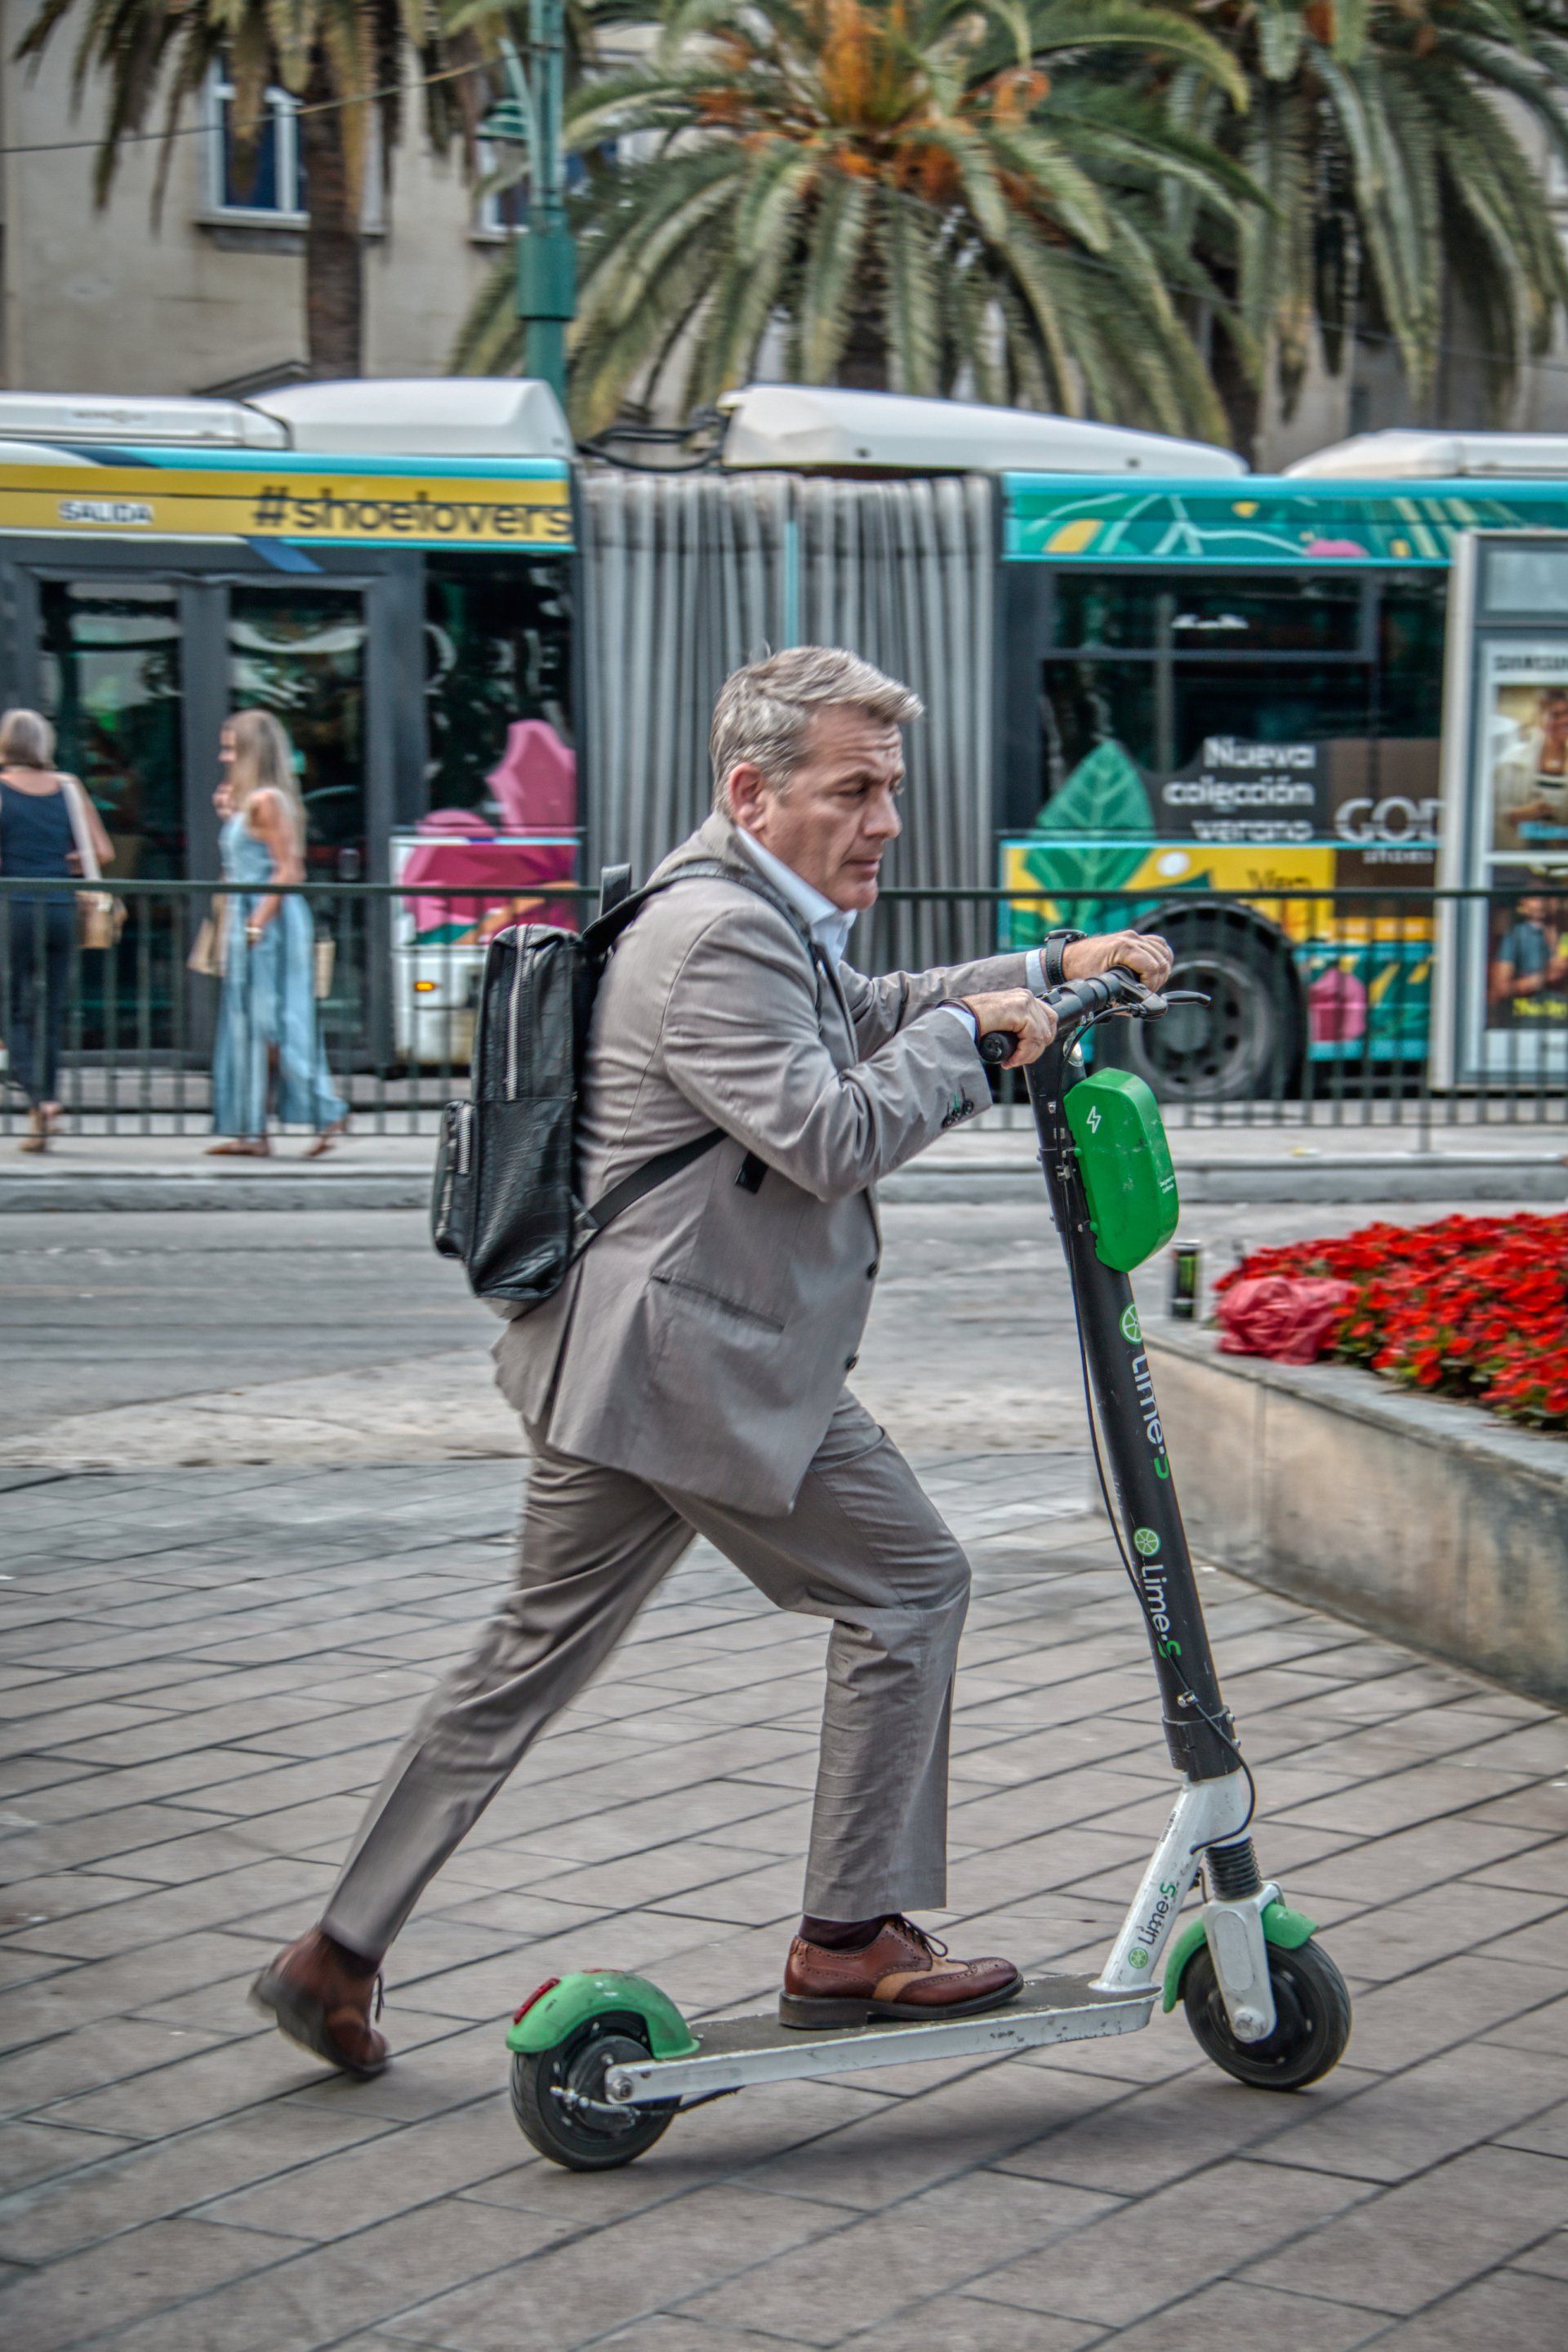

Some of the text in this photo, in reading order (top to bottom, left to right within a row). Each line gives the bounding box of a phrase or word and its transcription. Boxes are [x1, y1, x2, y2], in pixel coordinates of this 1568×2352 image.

[60, 501, 153, 523] SALIDA
[254, 487, 572, 535] #shoelovers
[1204, 737, 1315, 768] Nueva
[1163, 775, 1314, 812] colección
[1191, 819, 1313, 841] verano
